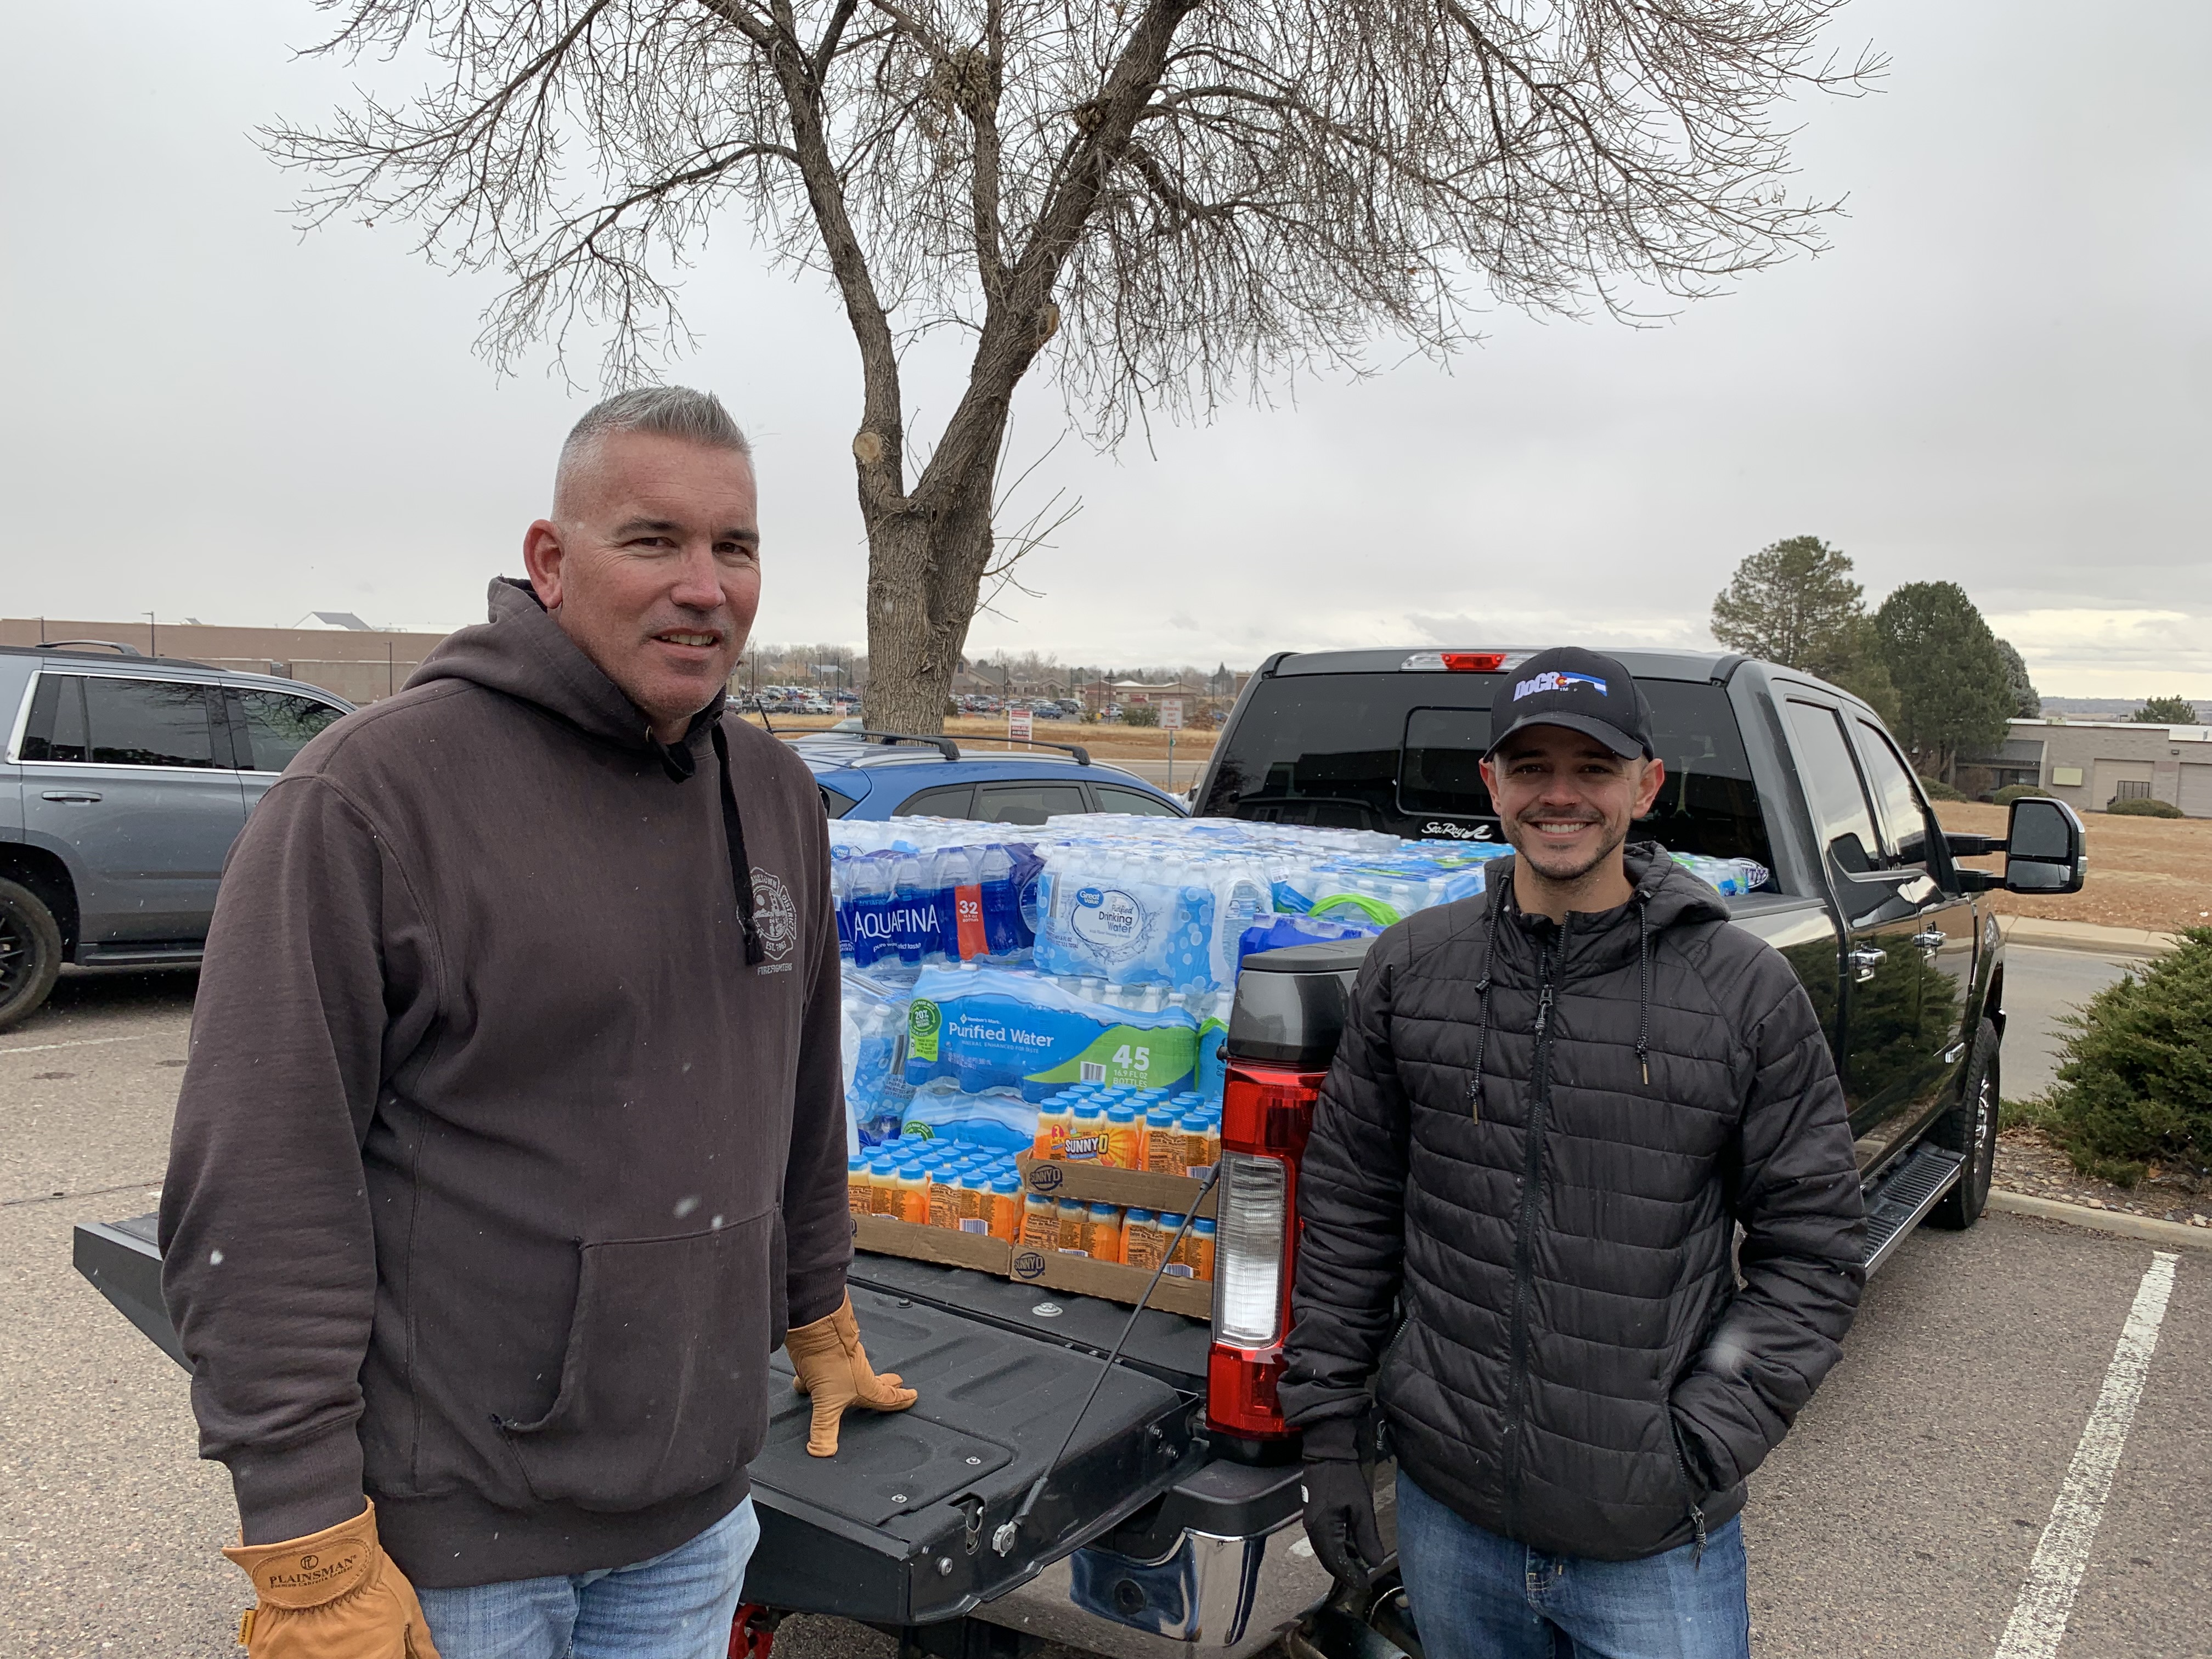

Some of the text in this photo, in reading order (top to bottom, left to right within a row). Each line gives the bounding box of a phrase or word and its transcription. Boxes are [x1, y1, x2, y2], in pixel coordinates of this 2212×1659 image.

[1421, 822, 1466, 838] Sea Ray
[1080, 890, 1100, 900] Great
[781, 894, 794, 932] DISTRICT
[960, 900, 978, 915] 32
[1111, 904, 1134, 915] Purified
[854, 904, 941, 943] AQUAFINA
[1099, 911, 1132, 926] Drinking
[1108, 922, 1132, 933] Water
[873, 943, 886, 952] pure
[758, 962, 792, 975] FIREFIGHTERS
[915, 1009, 929, 1020] 20%
[949, 1022, 1054, 1047] Purified Water
[984, 1042, 1014, 1050] ENHANCED
[1112, 1045, 1150, 1071] 45
[1113, 1077, 1148, 1088] BOTTLES
[1065, 1133, 1109, 1154] SUNNYD
[1030, 1168, 1062, 1183] SUNNYD
[1014, 1256, 1045, 1272] SUNNYD
[269, 1554, 355, 1585] PLAINSMAN
